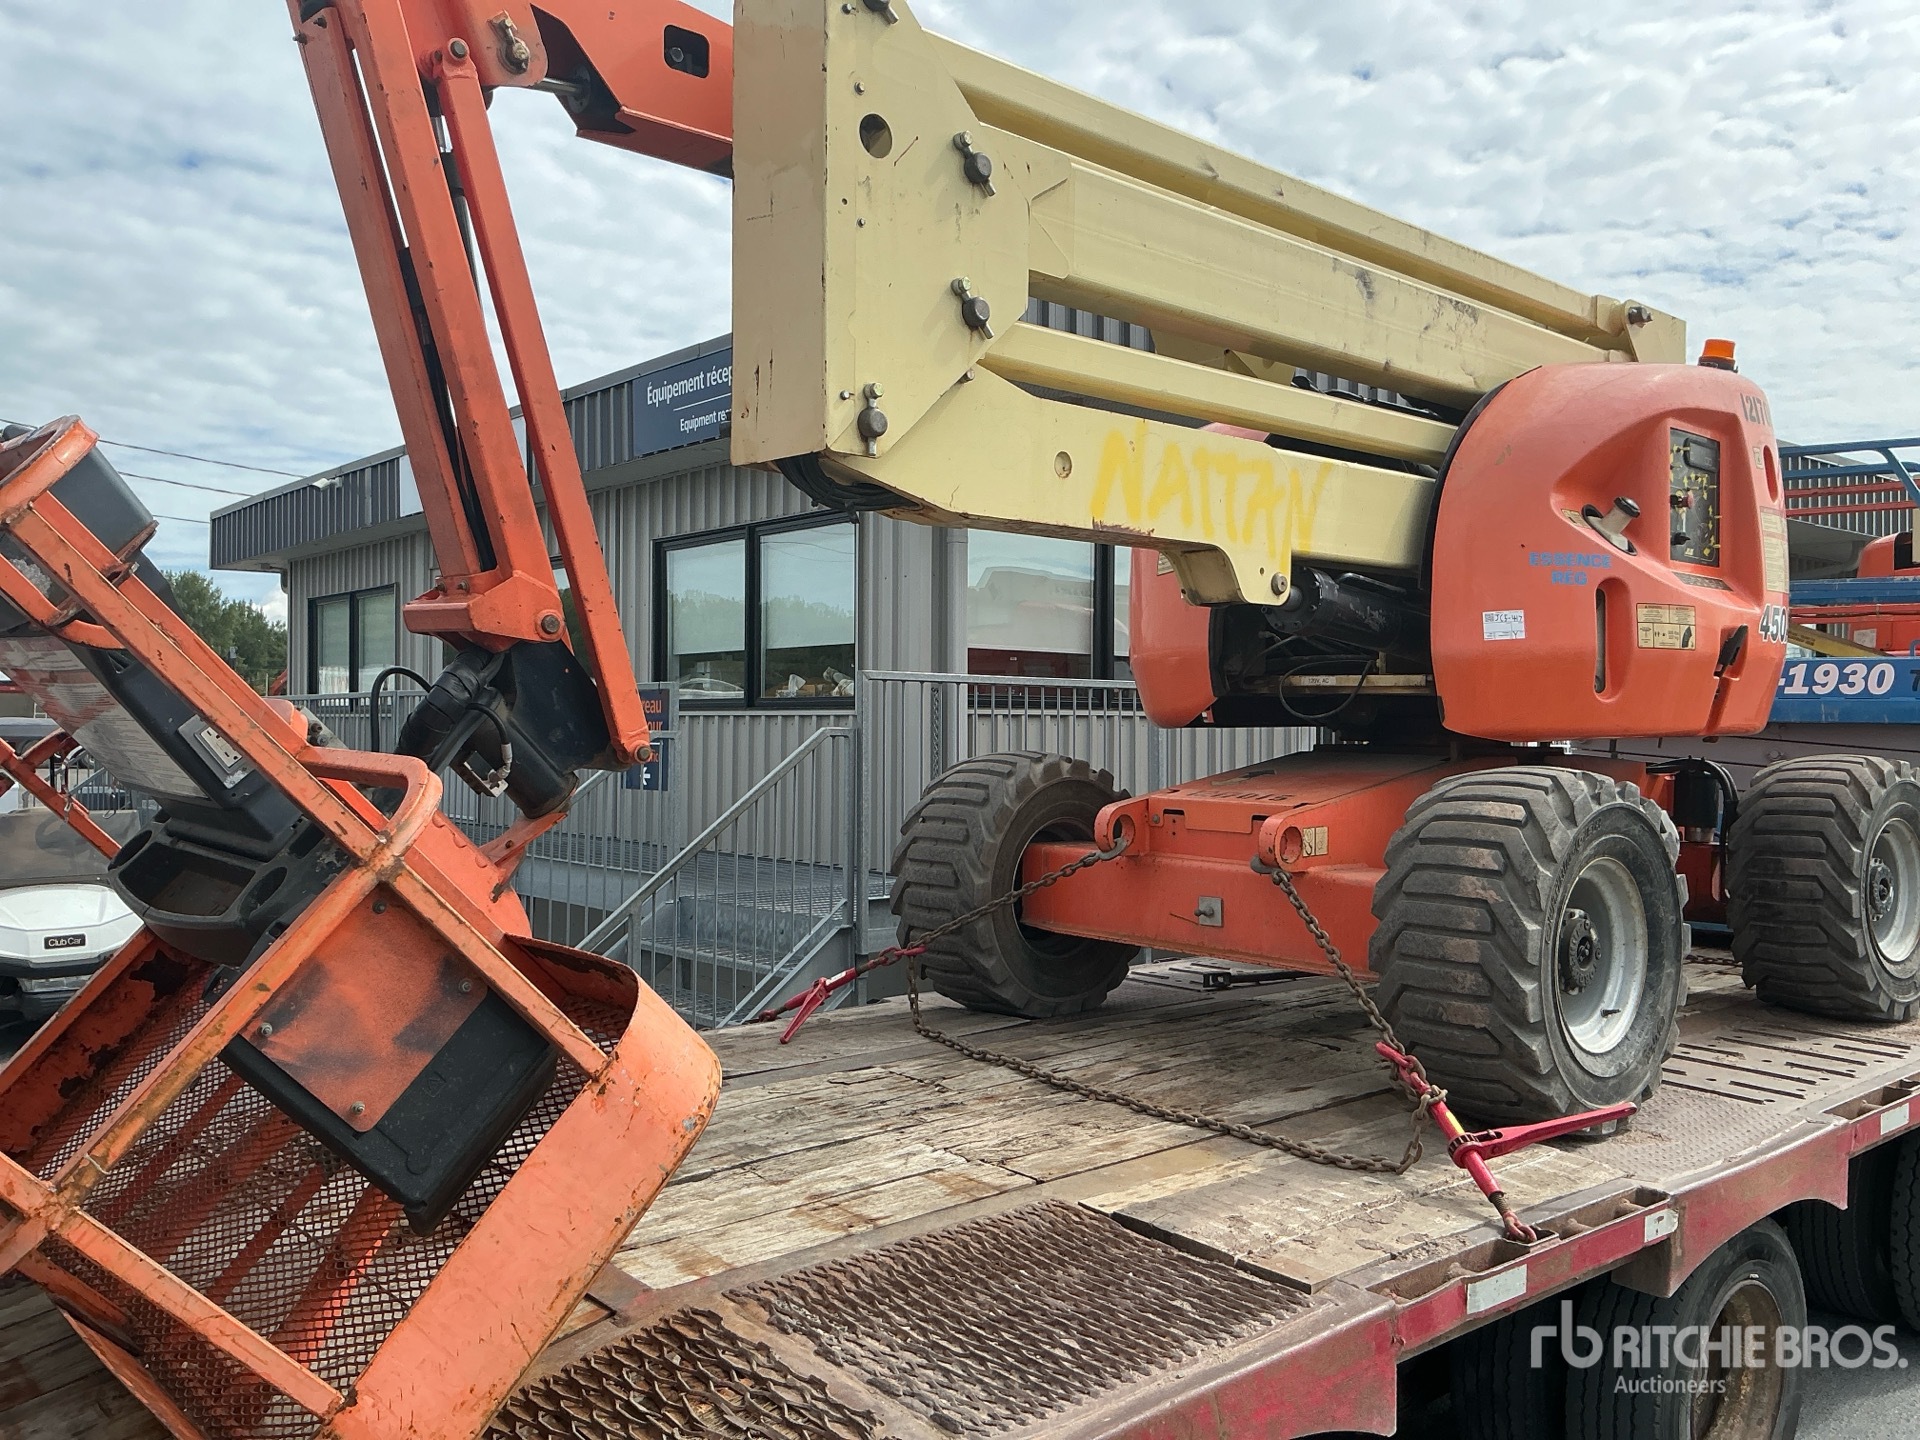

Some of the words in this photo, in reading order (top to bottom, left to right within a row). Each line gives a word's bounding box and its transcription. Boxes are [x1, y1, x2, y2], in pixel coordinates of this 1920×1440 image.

[647, 370, 705, 408] Équipement
[680, 411, 717, 434] Equipment
[1529, 552, 1611, 569] ESSENCE
[48, 938, 67, 947] Club
[67, 937, 82, 945] Car
